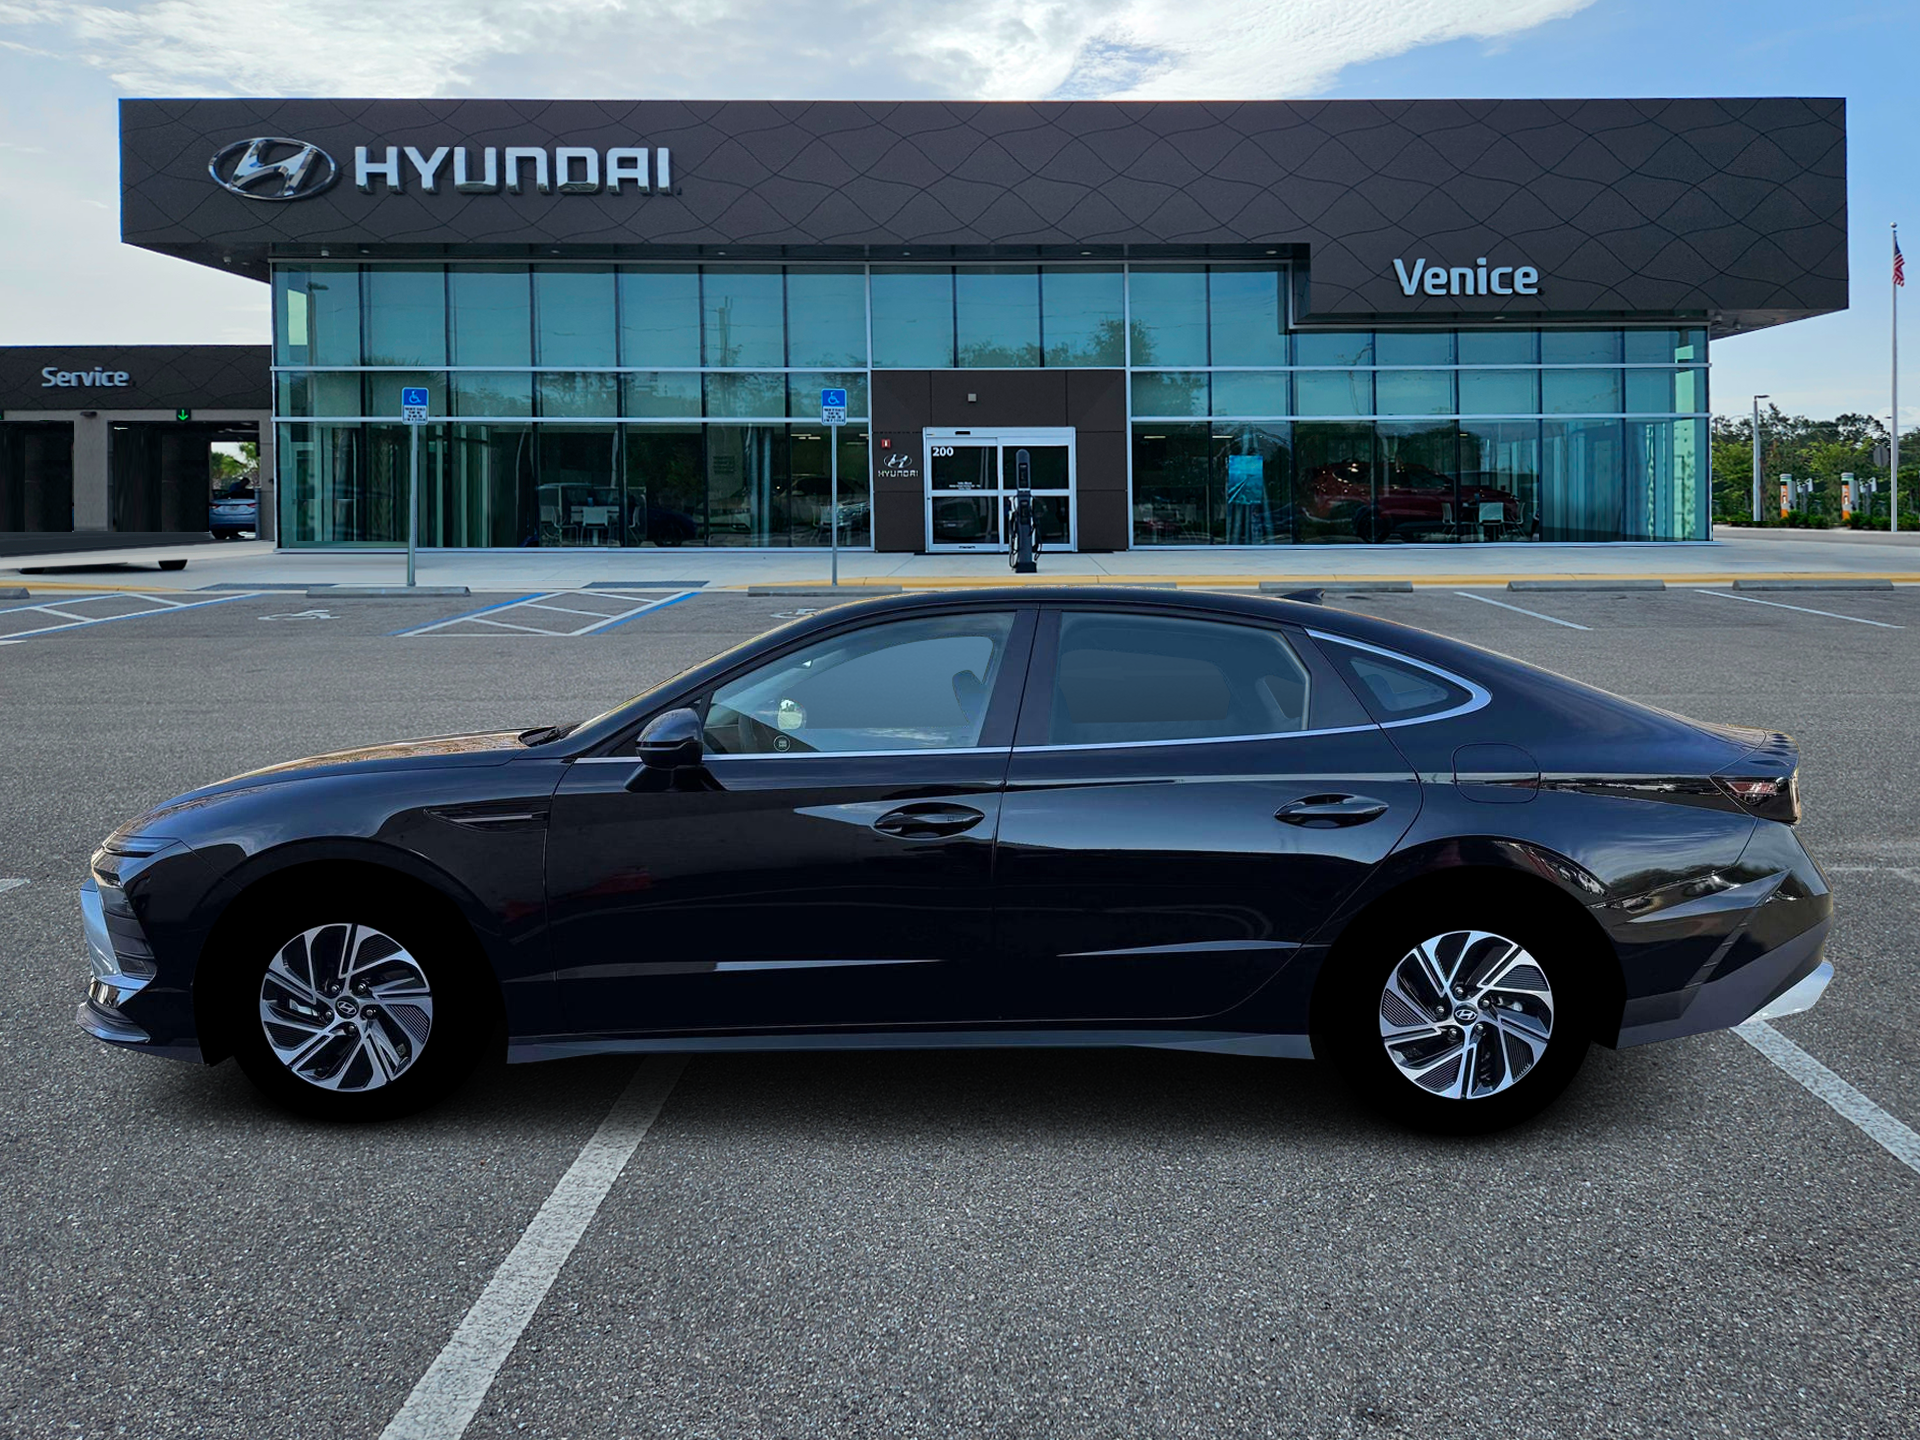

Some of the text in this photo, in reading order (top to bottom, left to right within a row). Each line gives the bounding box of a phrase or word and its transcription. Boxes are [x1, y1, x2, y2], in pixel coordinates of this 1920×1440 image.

[354, 146, 670, 194] HYUNDAI
[1392, 256, 1539, 296] Venice
[41, 366, 130, 387] Service
[932, 446, 954, 457] 200
[877, 469, 919, 478] HYUNDAI
